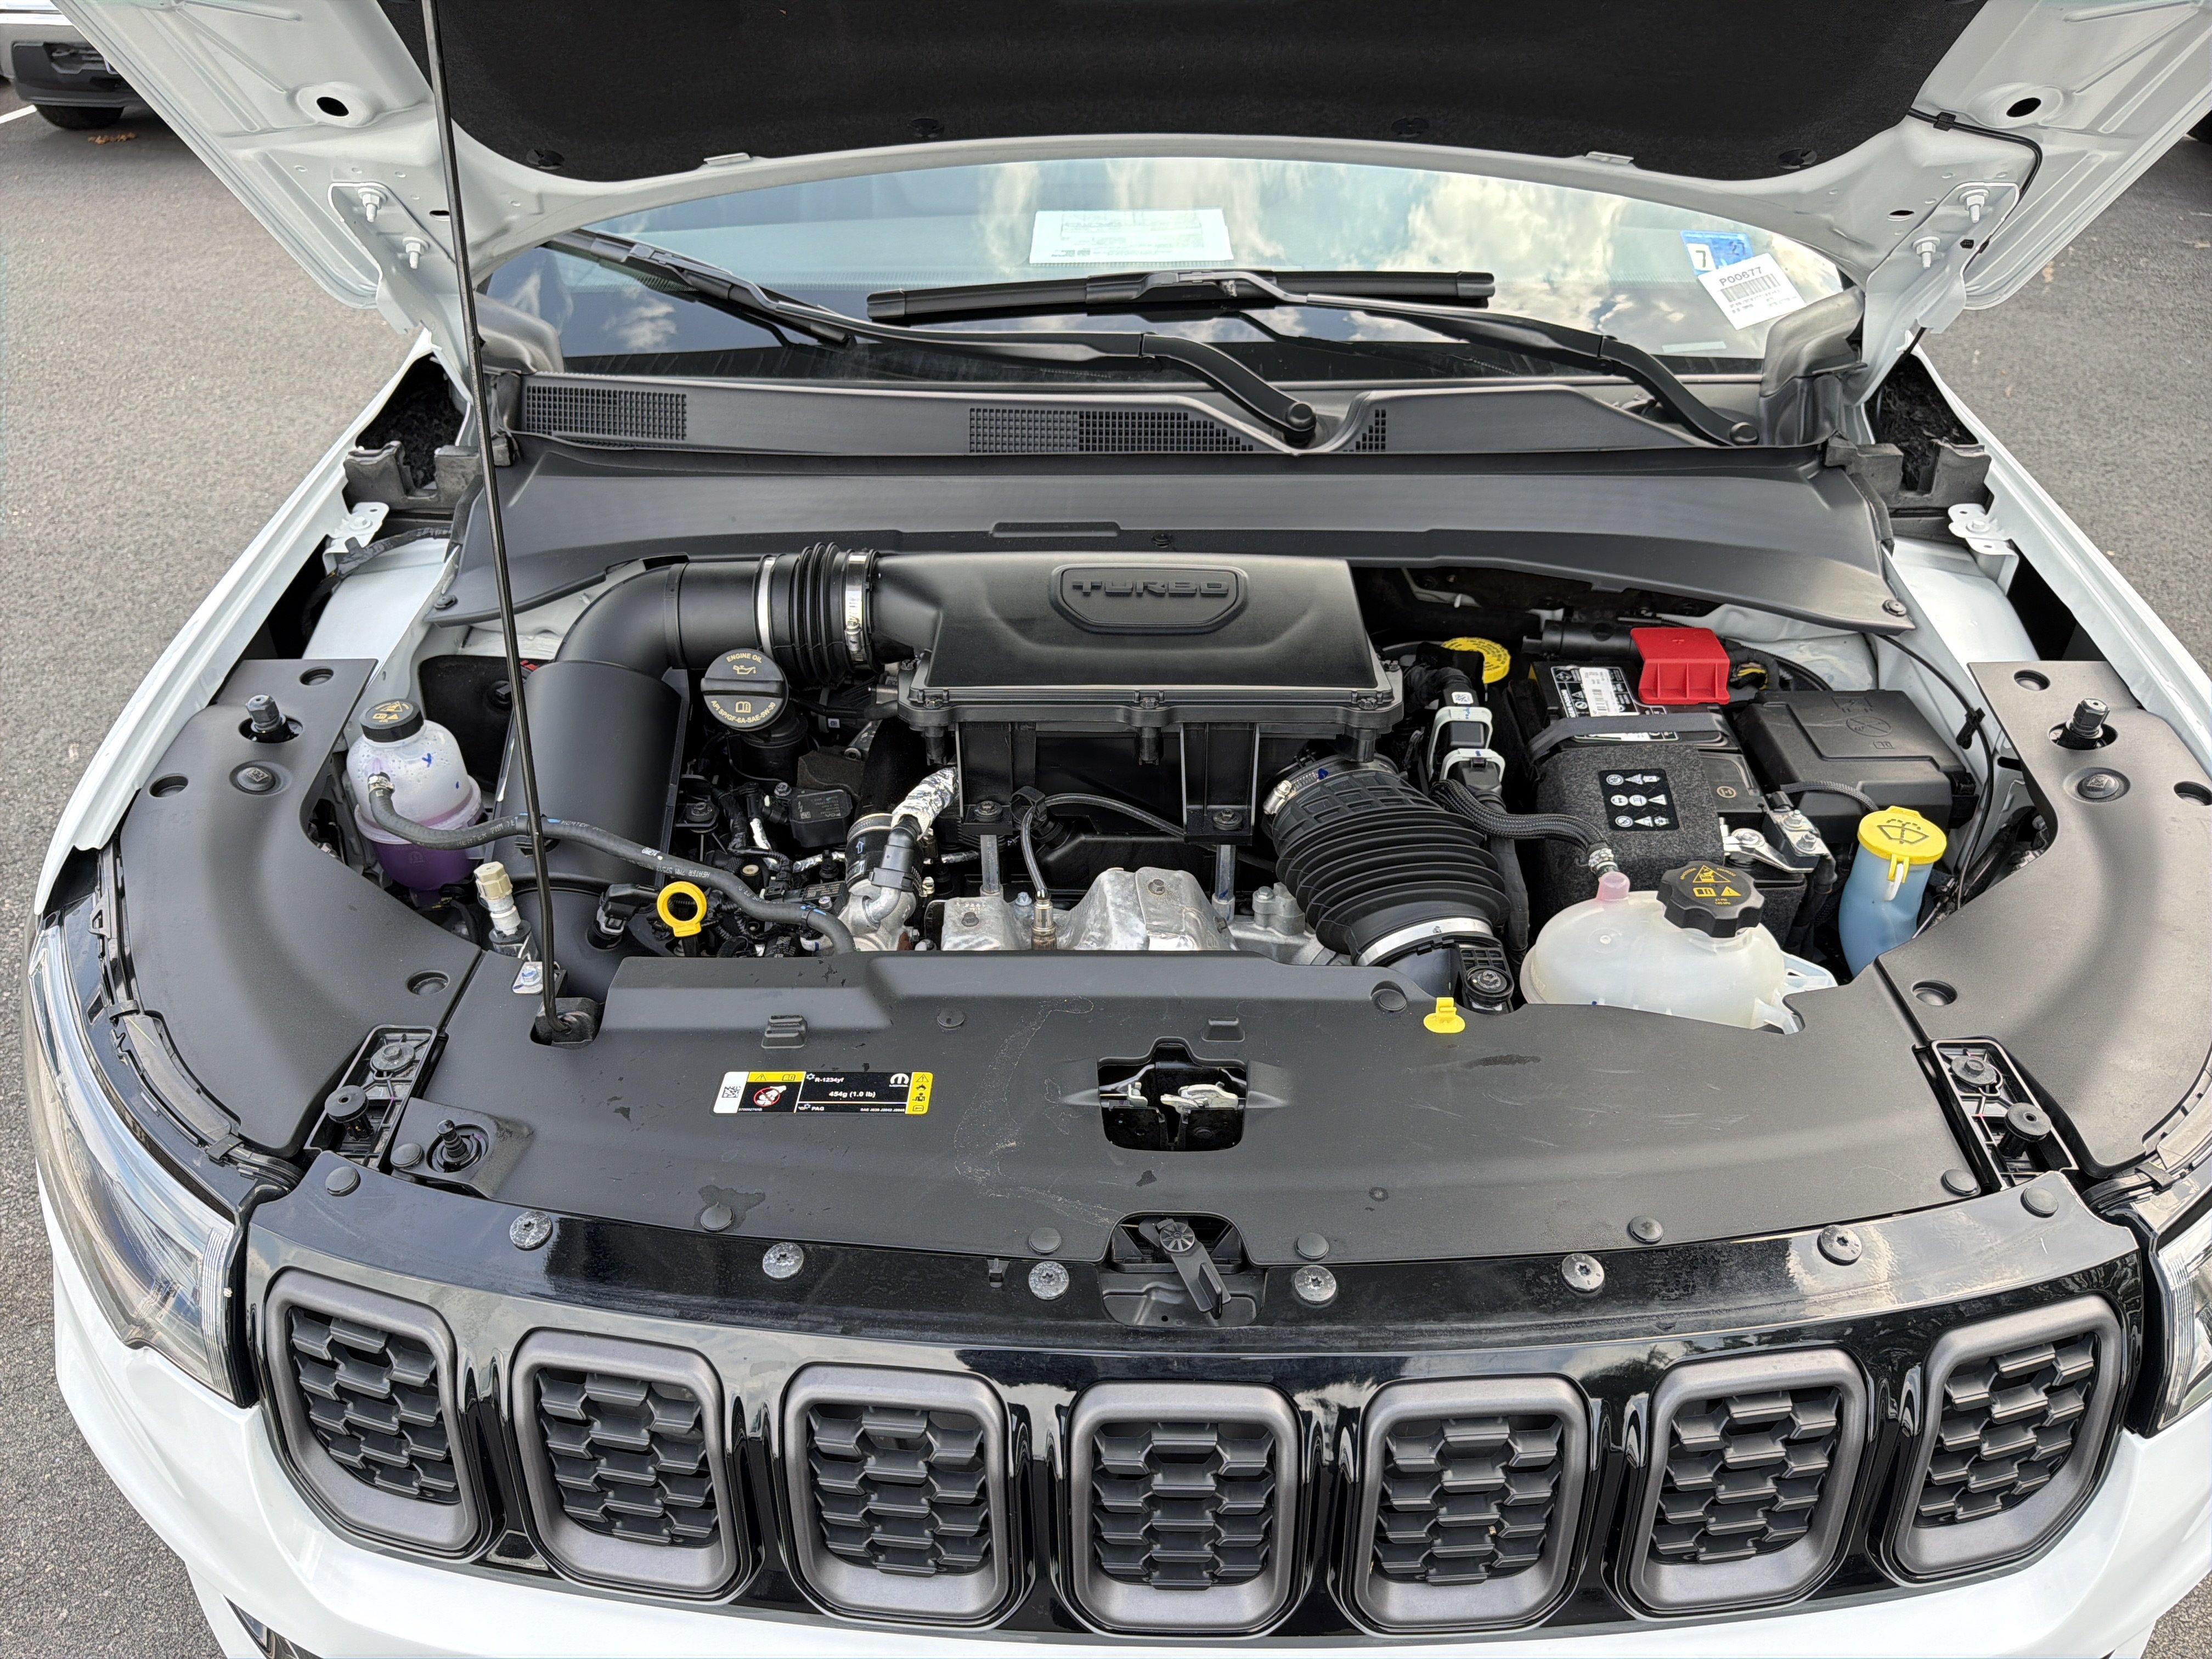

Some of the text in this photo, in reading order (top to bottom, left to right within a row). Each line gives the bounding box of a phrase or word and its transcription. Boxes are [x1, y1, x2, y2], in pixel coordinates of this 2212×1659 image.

[1695, 250, 1706, 268] 7
[1072, 580, 1229, 596] TURBO
[726, 653, 763, 664] ENGINE OIL
[711, 700, 776, 724] API SP/GF-6A-SAE-5W-30
[688, 870, 710, 878] HEATER
